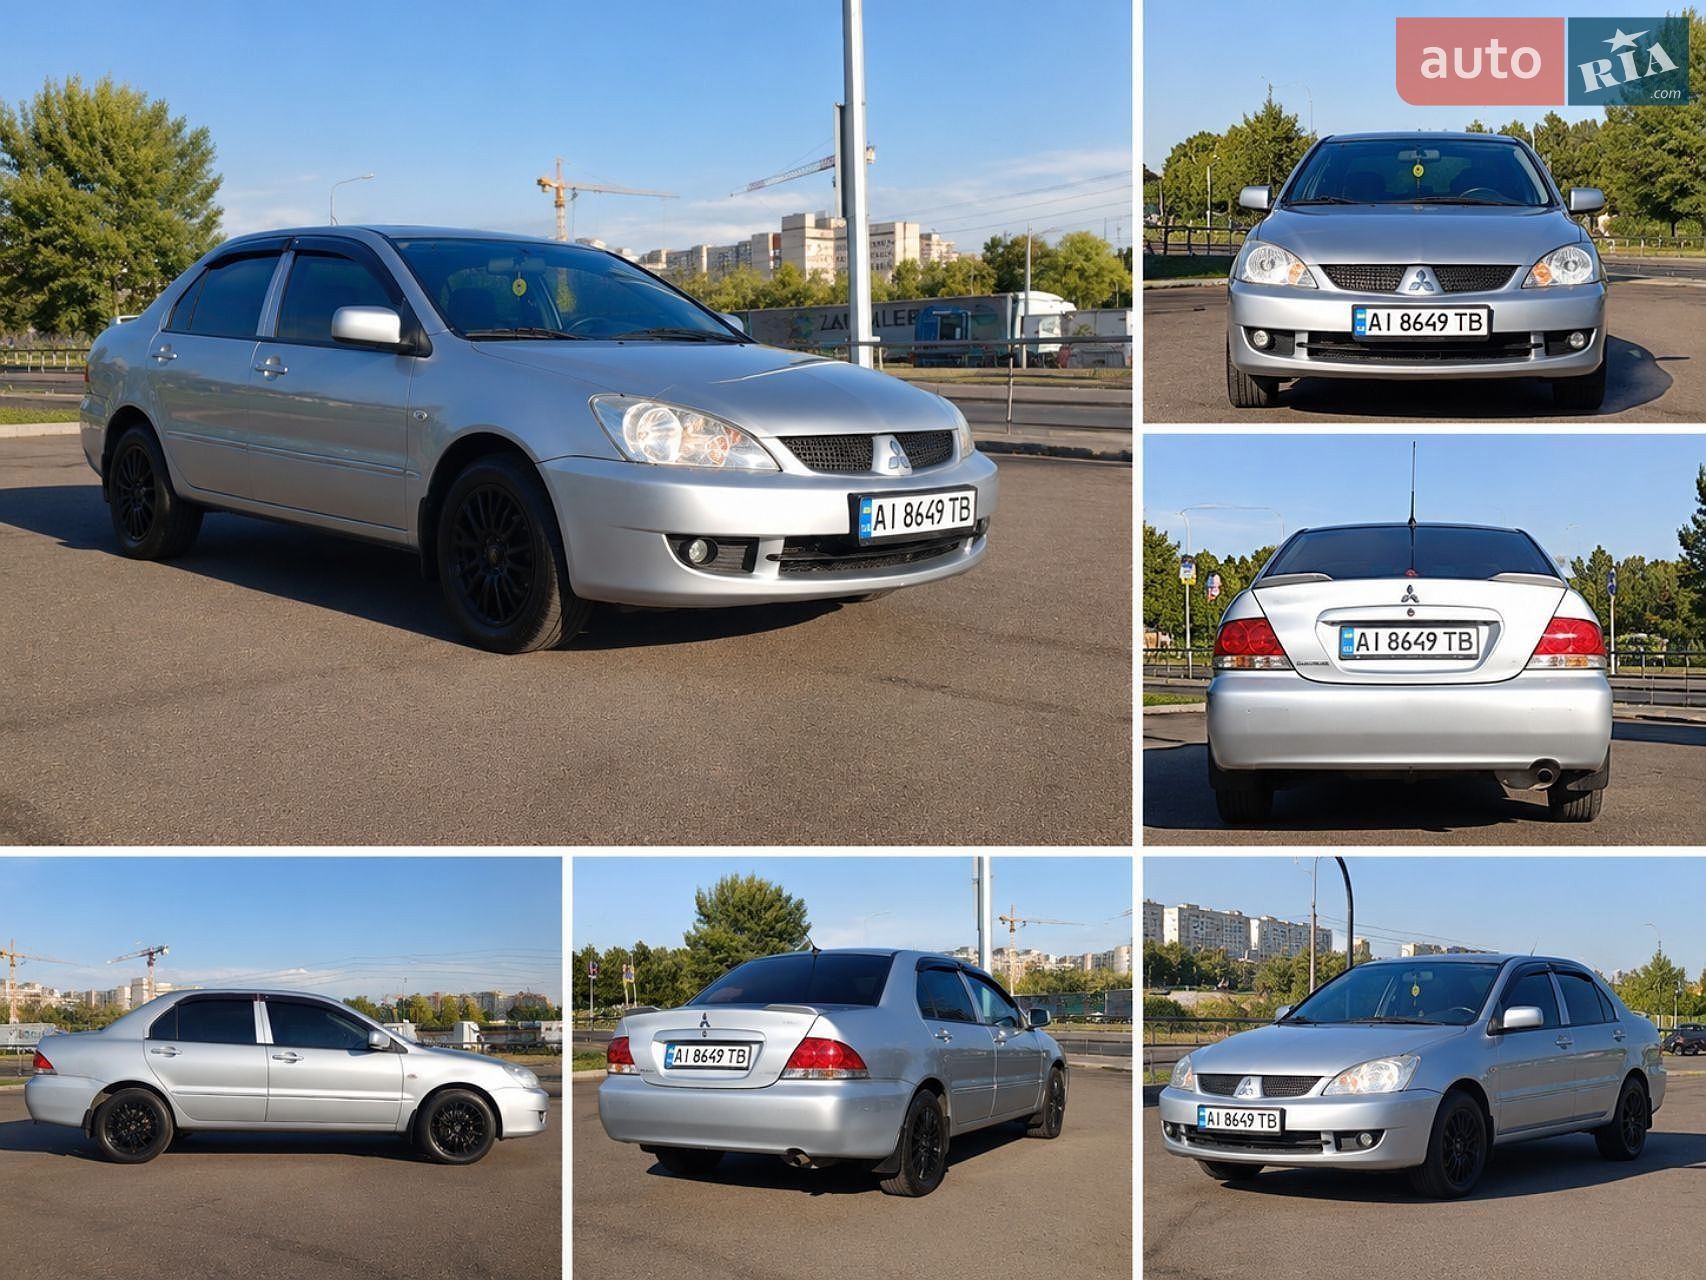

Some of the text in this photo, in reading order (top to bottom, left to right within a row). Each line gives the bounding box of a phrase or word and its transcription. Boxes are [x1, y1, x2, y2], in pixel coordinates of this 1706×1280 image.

[1368, 312, 1483, 332] AI 8649 TB
[873, 496, 971, 531] AI 8649 TB
[1356, 631, 1473, 651] AI 8649 TB
[674, 1048, 746, 1064] AI 8649 TB
[1207, 1111, 1277, 1129] AI 8649 TB
